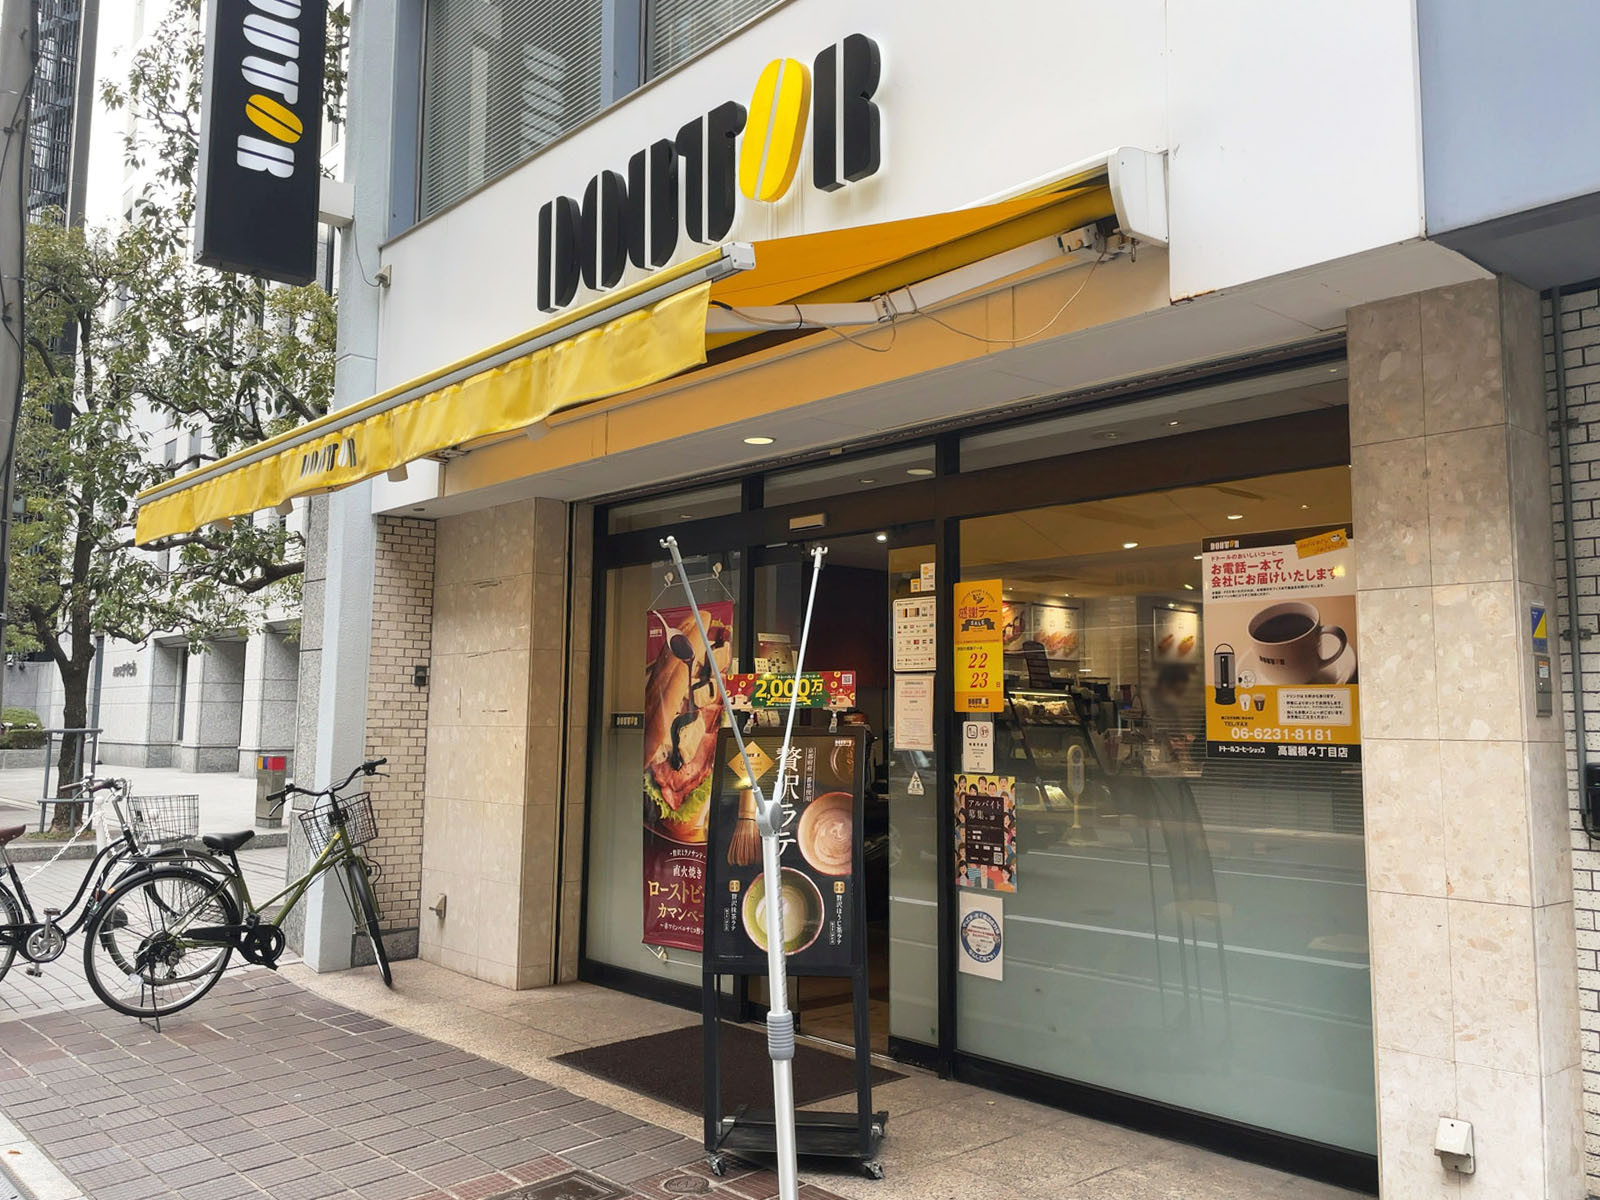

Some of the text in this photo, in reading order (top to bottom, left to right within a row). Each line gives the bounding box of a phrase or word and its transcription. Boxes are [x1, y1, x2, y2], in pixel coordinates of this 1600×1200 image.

[537, 33, 881, 313] DOUTOR
[1210, 539, 1240, 551] DOUTOR
[1211, 551, 1284, 562] ドトールのおいしいコーヒー
[1211, 558, 1284, 576] お電話一本で
[1211, 566, 1337, 588] 会社にお届けいたします
[958, 605, 998, 619] 感謝デー
[968, 652, 988, 669] 22
[970, 672, 989, 689] 23
[1231, 727, 1332, 741] 06-6231-8181
[1277, 745, 1348, 758] 高麗橋4丁目店
[968, 800, 1002, 809] アルバイト
[673, 865, 702, 880] 直火焼き
[648, 880, 705, 904] ローストビ
